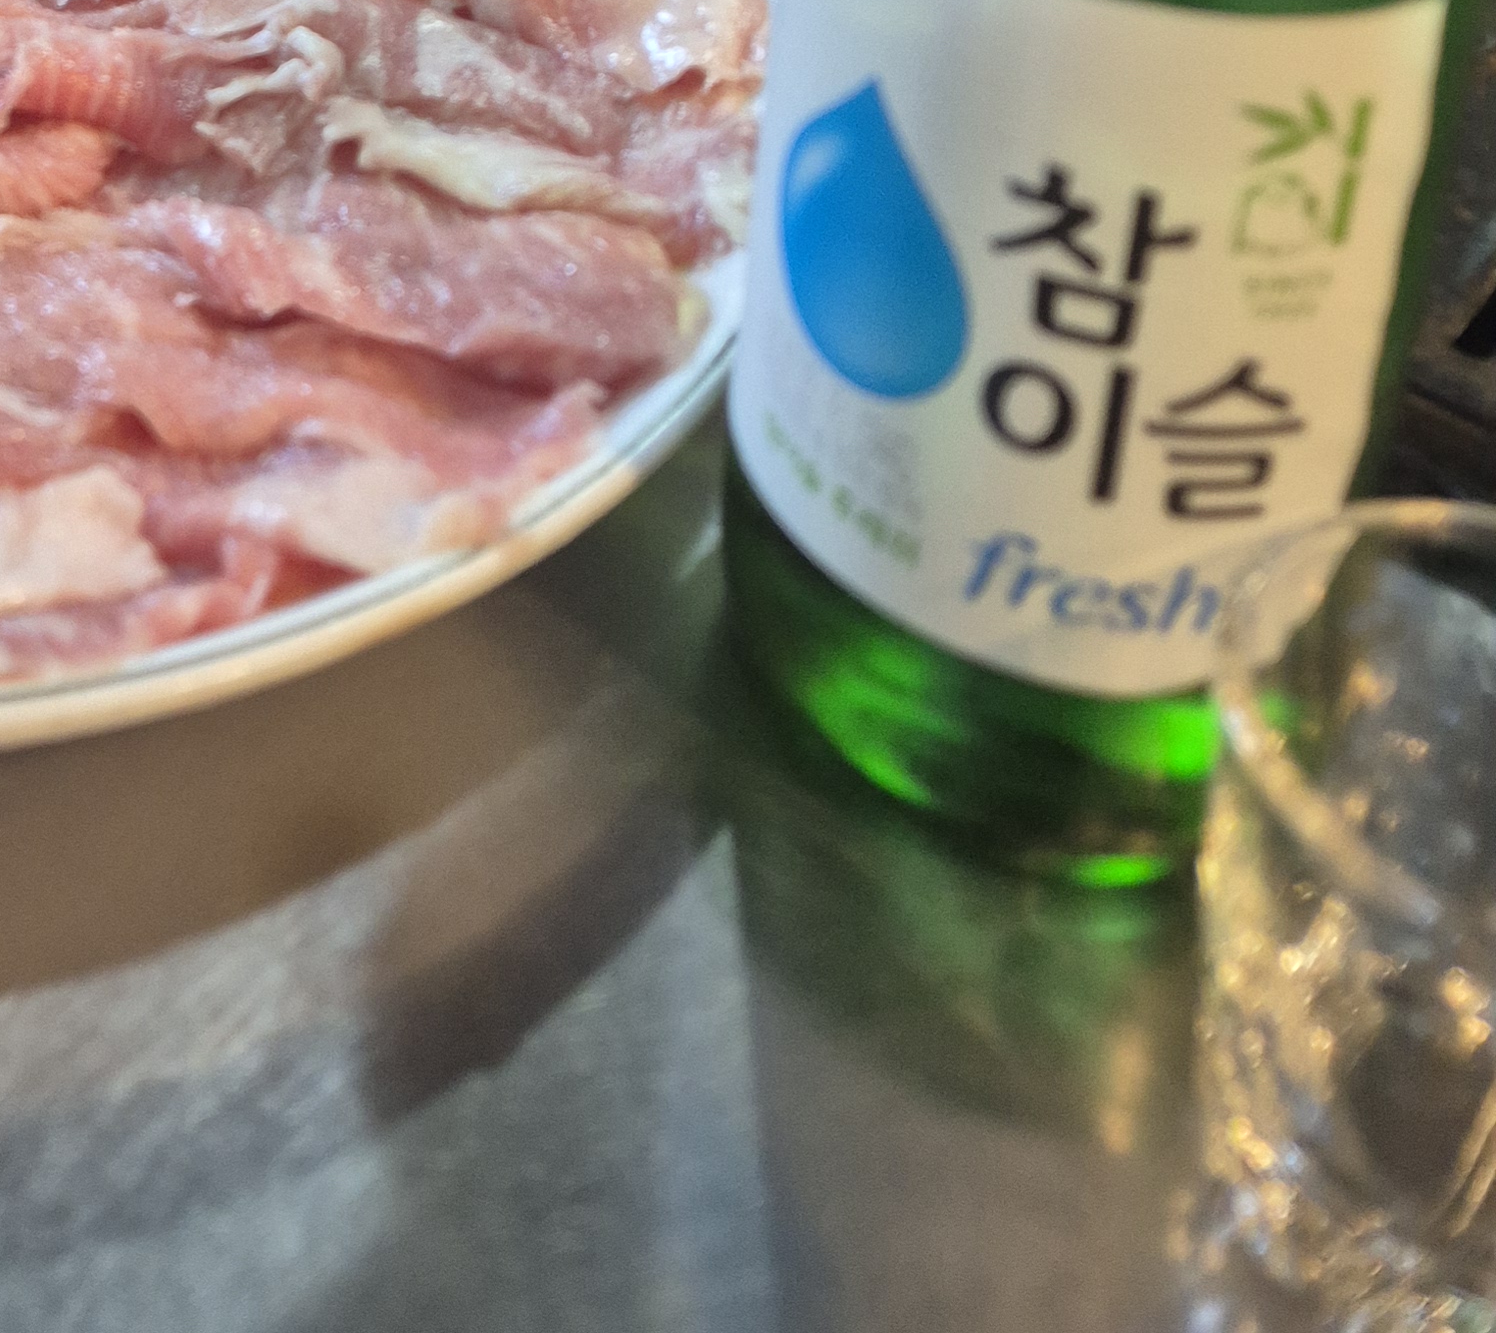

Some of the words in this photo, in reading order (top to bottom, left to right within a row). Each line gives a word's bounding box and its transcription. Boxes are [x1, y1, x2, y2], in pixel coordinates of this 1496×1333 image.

[988, 161, 1200, 349] 참
[980, 353, 1307, 523] 이슬
[962, 531, 1222, 636] fresh
